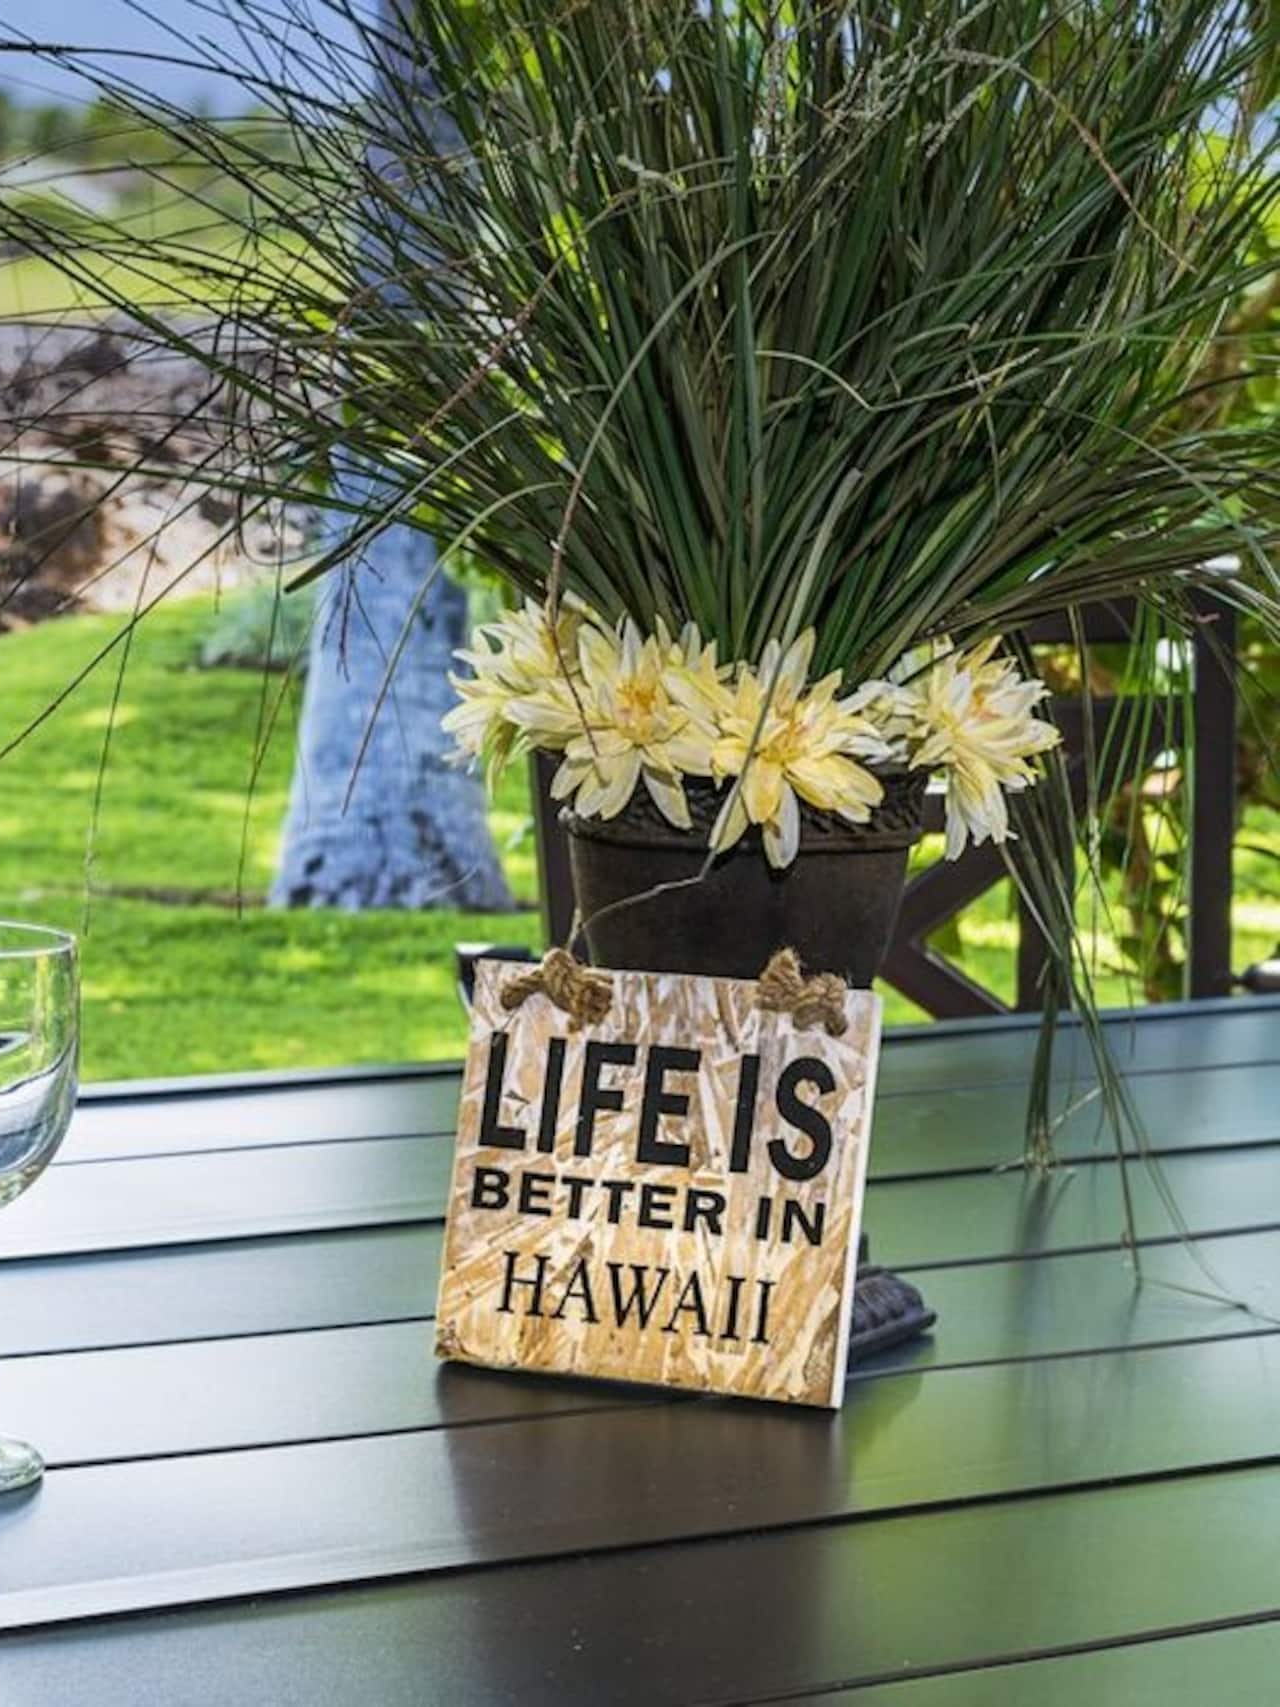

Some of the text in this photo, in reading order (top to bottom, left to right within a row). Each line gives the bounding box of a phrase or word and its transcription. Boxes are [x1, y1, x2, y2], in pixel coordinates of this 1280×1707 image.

[478, 1031, 837, 1183] LIFE IS
[470, 1167, 826, 1246] BETTER IN
[496, 1250, 776, 1345] HAWAII
